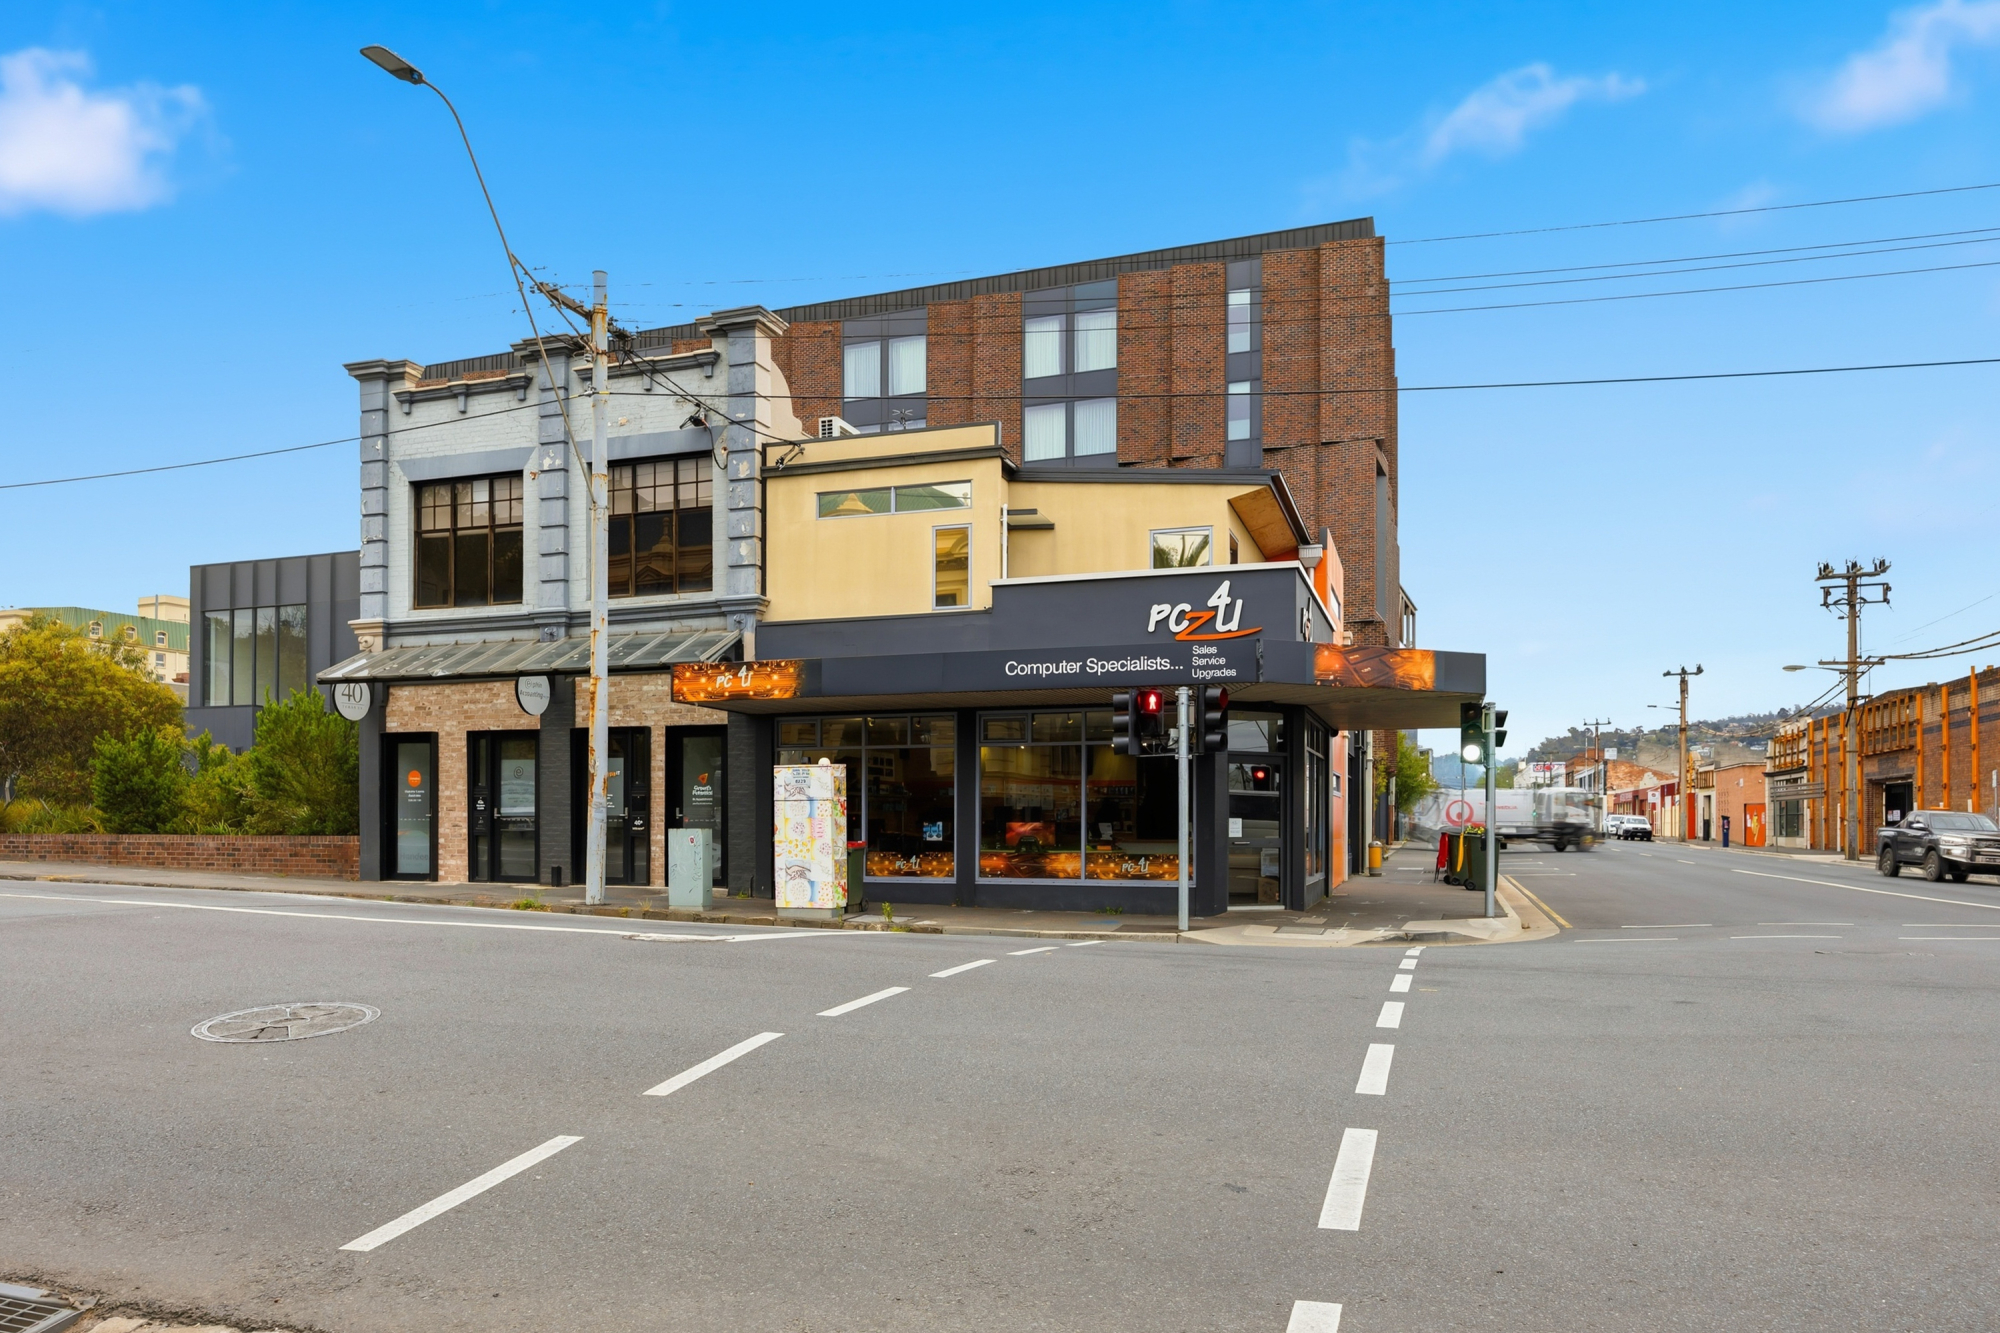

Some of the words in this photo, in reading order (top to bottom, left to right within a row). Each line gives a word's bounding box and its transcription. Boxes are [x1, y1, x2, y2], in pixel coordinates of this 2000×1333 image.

[1192, 645, 1218, 654] Sales
[1192, 656, 1226, 666] Service
[1005, 660, 1083, 678] Computer
[1192, 668, 1237, 679] Upgrades
[341, 683, 363, 703] 40
